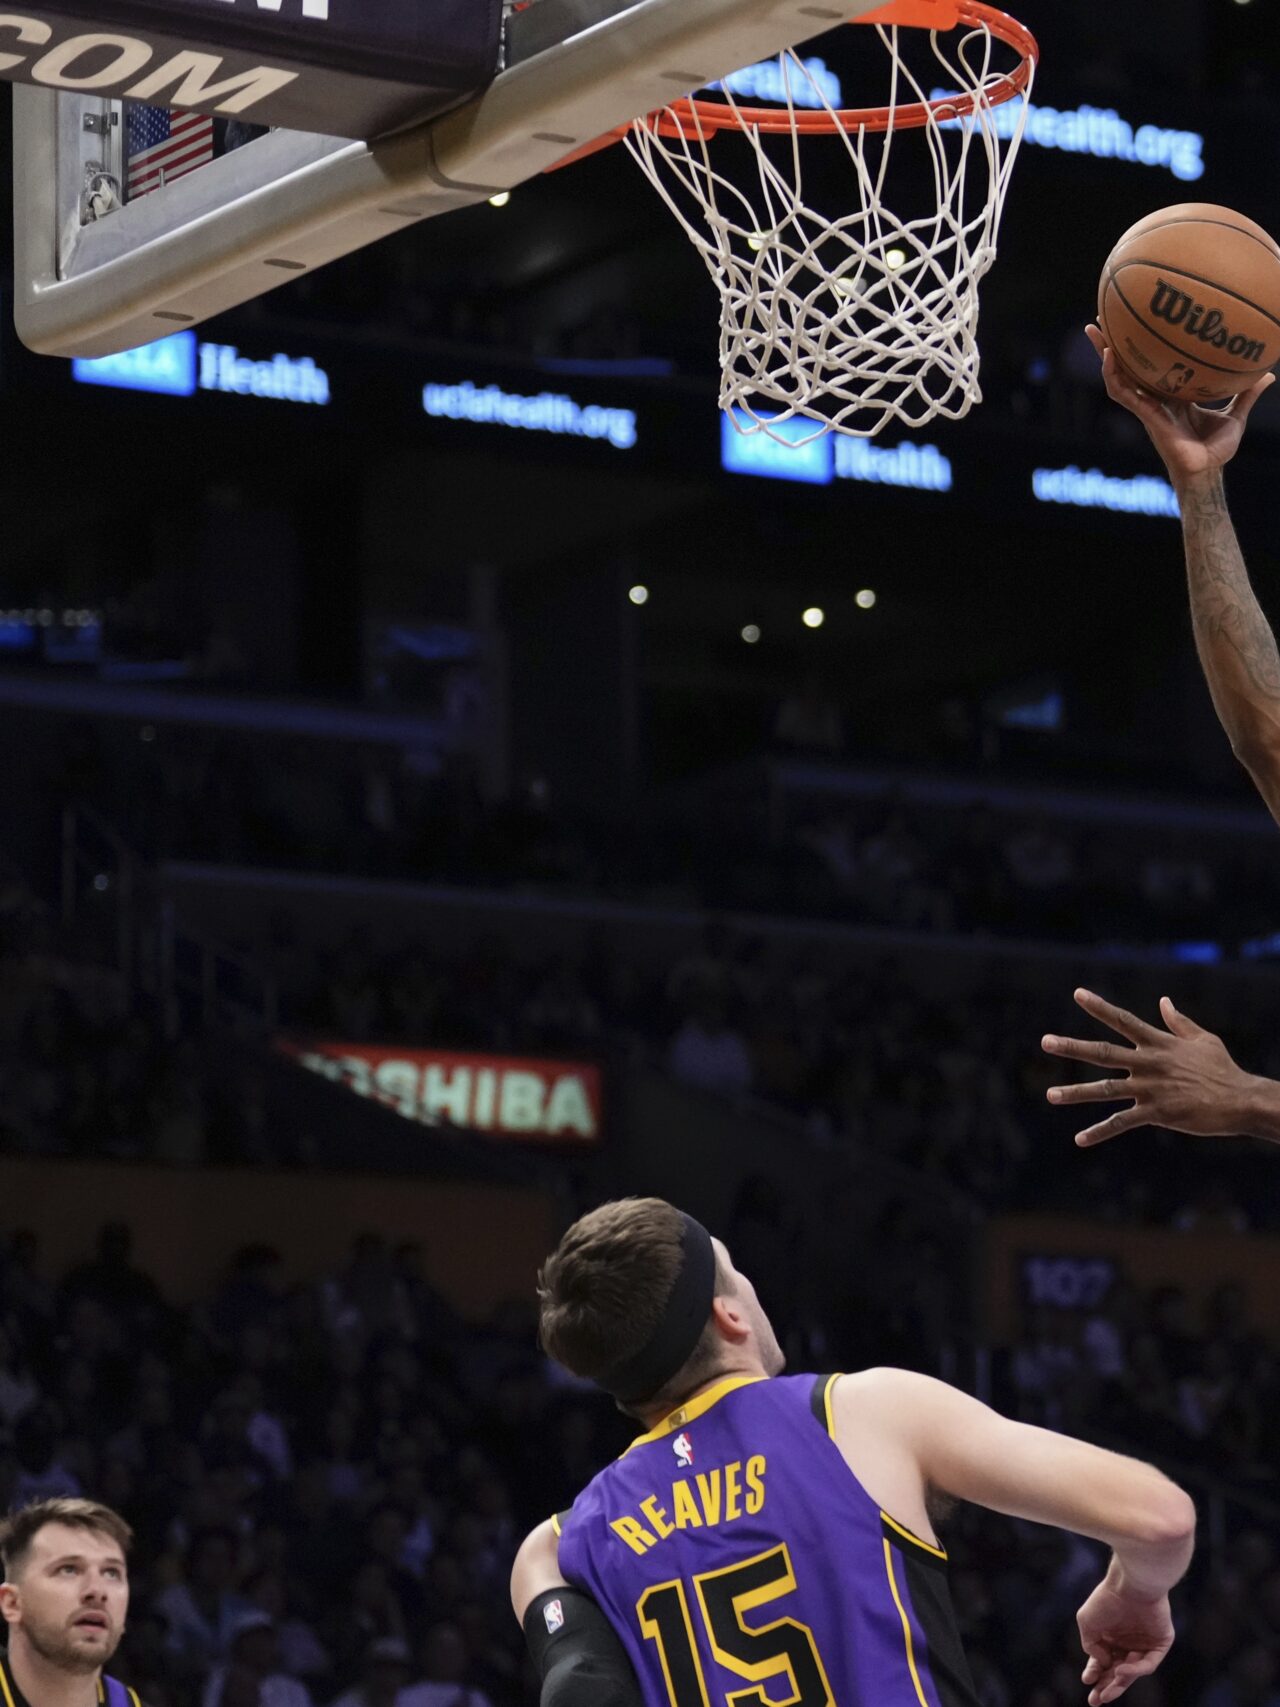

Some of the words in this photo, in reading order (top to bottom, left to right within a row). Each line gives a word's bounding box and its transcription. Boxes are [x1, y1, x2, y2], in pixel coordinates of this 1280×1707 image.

[1149, 277, 1266, 363] Wilson
[200, 342, 330, 404] Health
[834, 433, 951, 491] Health
[610, 1455, 767, 1556] REAVES
[635, 1542, 838, 1707] 15
